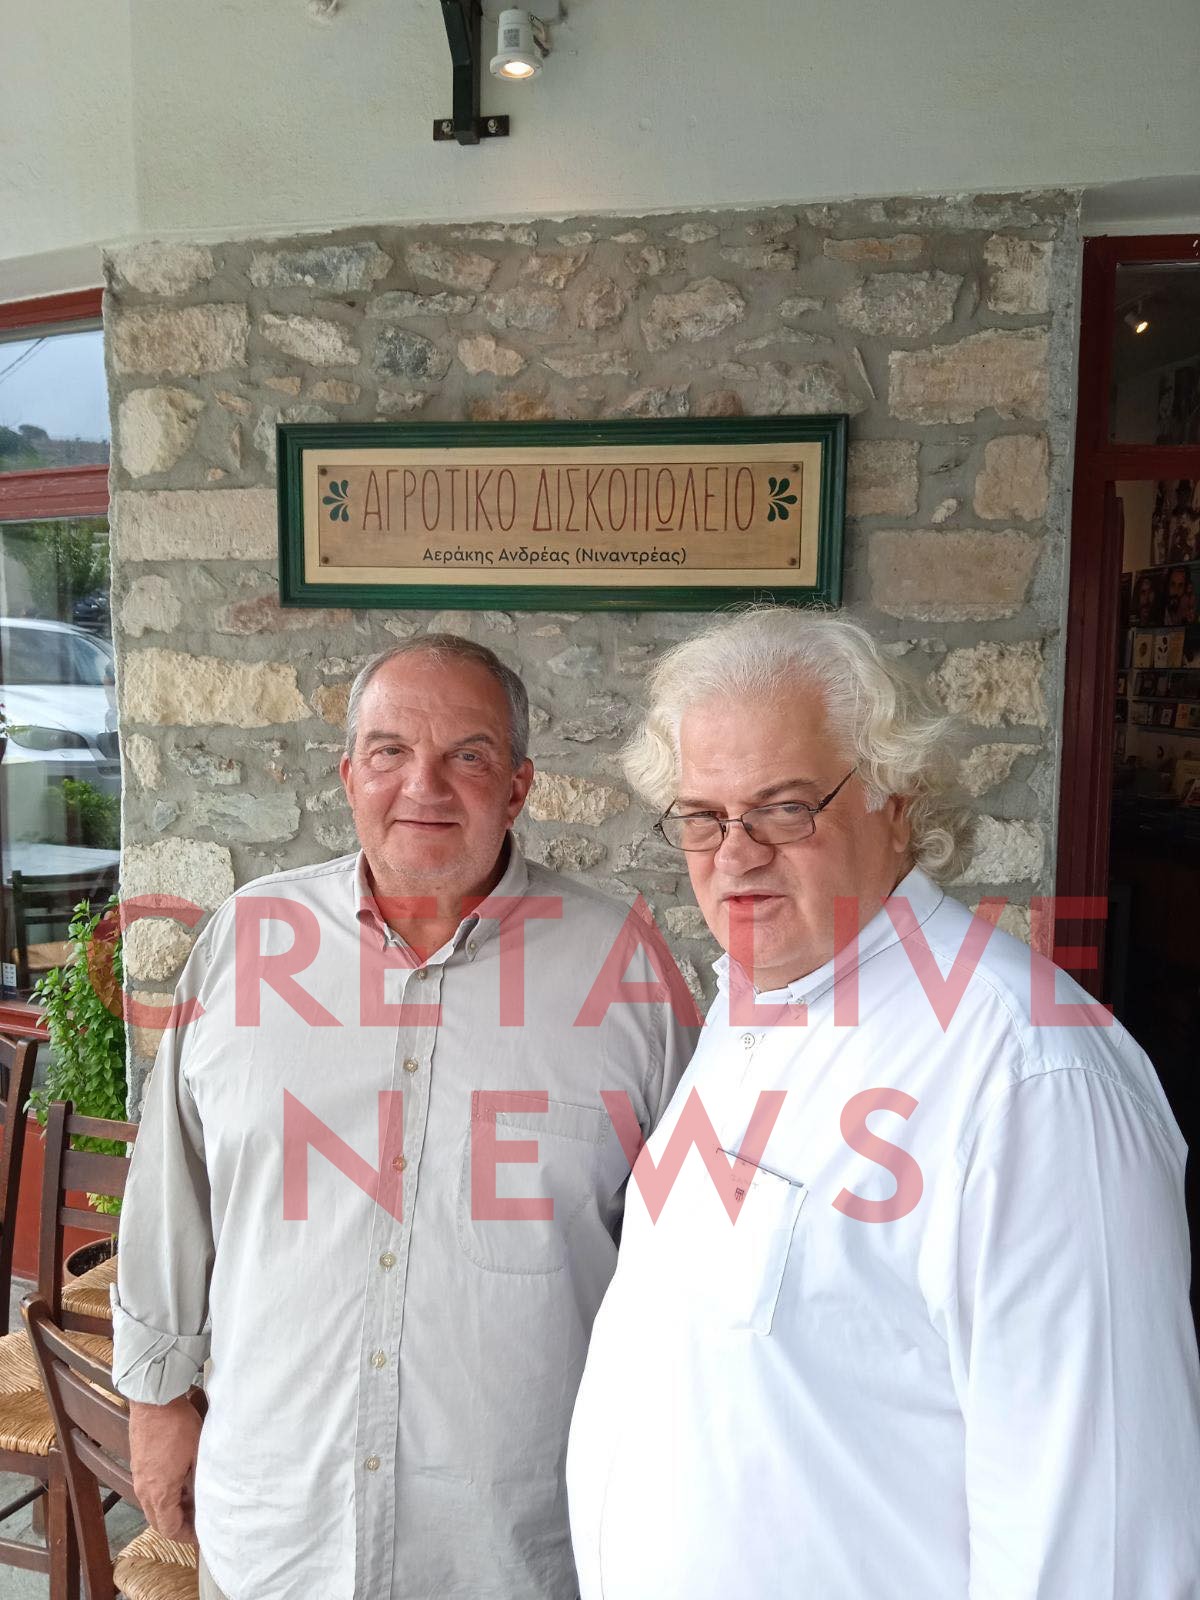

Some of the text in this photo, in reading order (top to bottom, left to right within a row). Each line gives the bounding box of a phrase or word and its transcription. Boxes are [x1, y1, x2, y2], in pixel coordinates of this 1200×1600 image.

[362, 466, 755, 532] ΑΓΡΟΤΙΚΟ ΔΙΣΚΟΠΩΛΕΙΟ
[422, 545, 687, 565] Αεράκης Ανδρέας (Νιναντρέας)
